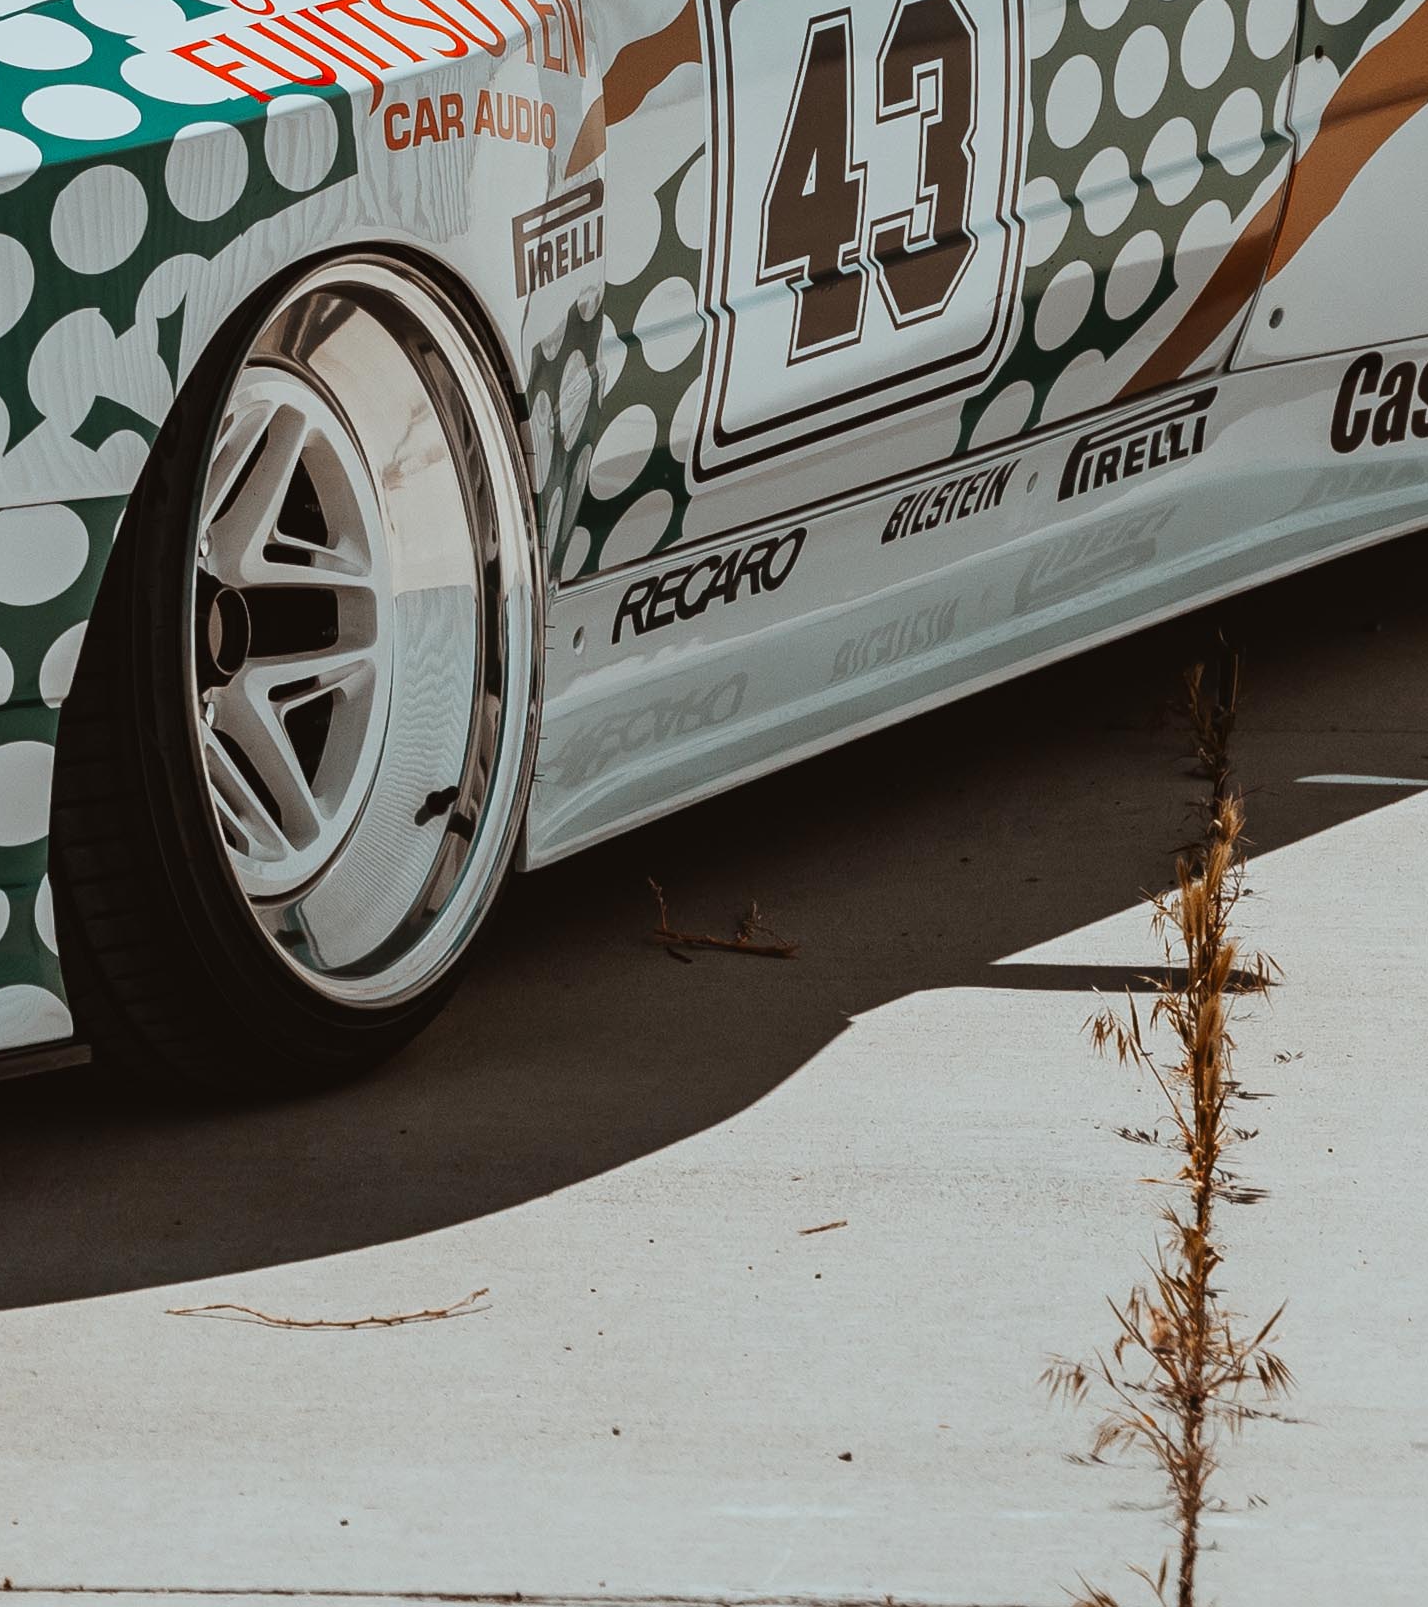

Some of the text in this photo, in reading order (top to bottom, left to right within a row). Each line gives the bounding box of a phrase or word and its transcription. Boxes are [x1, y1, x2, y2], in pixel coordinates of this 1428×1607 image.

[383, 89, 557, 152] CAR AUDIO
[511, 177, 605, 300] PIRELLI
[880, 458, 1021, 546] BILSTEIN
[1057, 387, 1219, 502] PIRELLI
[610, 527, 809, 645] RECARO
